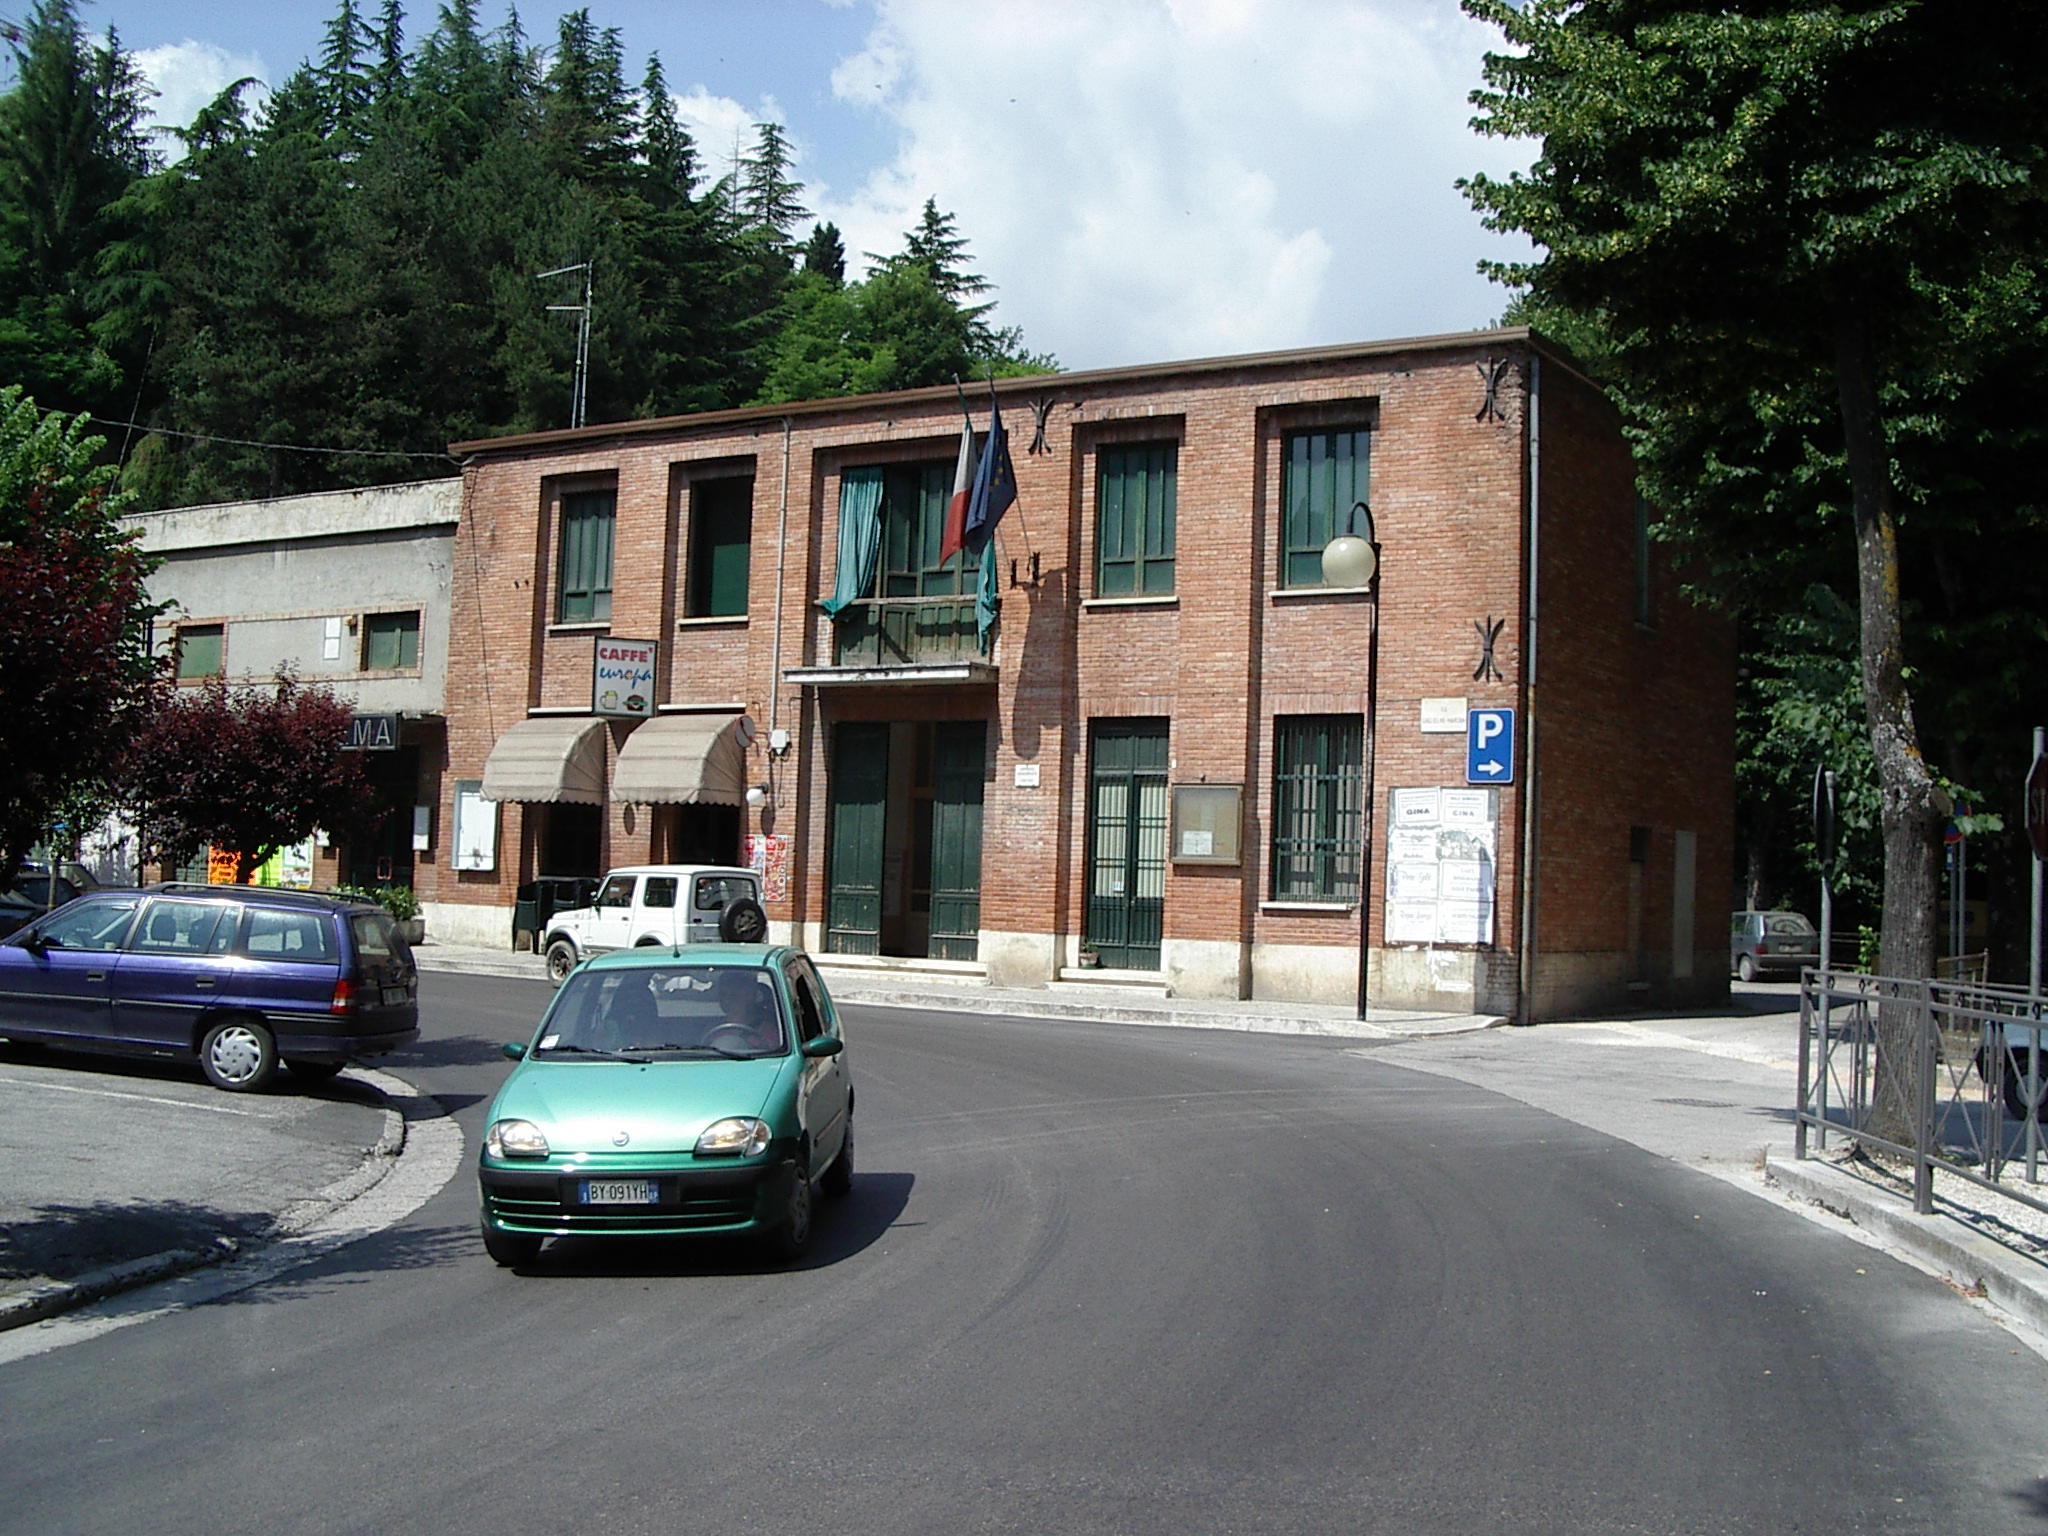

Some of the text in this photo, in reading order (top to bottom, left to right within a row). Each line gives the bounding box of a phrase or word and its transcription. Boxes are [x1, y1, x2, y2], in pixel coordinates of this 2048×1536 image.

[353, 718, 391, 745] MA
[1477, 713, 1504, 749] P
[2031, 788, 2048, 825] ST
